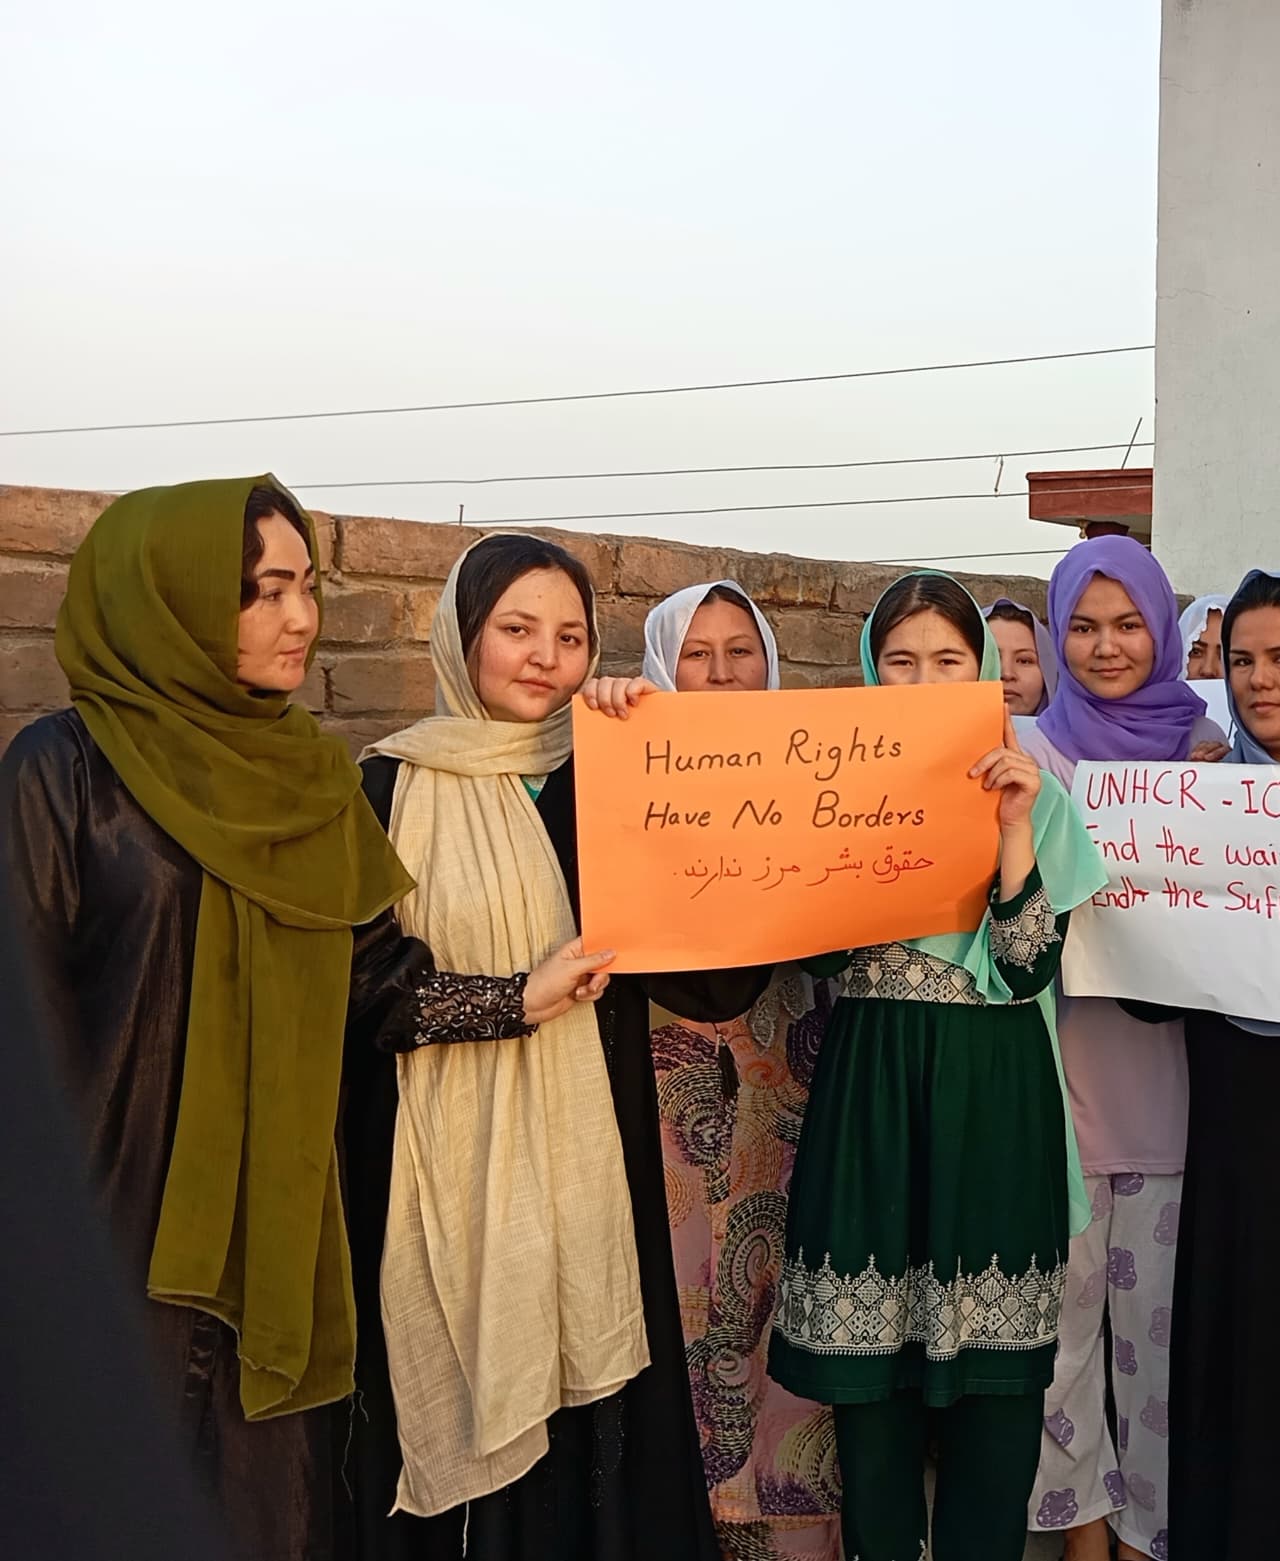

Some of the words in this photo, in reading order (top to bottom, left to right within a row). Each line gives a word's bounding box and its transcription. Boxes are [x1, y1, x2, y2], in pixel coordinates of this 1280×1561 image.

[645, 740, 762, 776] Human
[784, 726, 902, 782] Rights
[1086, 768, 1206, 811] UNHCR
[643, 801, 712, 832] Have
[732, 799, 783, 828] No
[812, 790, 926, 830] Borders
[1085, 818, 1140, 864] nd
[1155, 825, 1206, 867] the
[752, 856, 801, 891] مرز
[805, 847, 864, 887] بشر
[872, 845, 935, 885] حقوق
[1161, 876, 1209, 909] the
